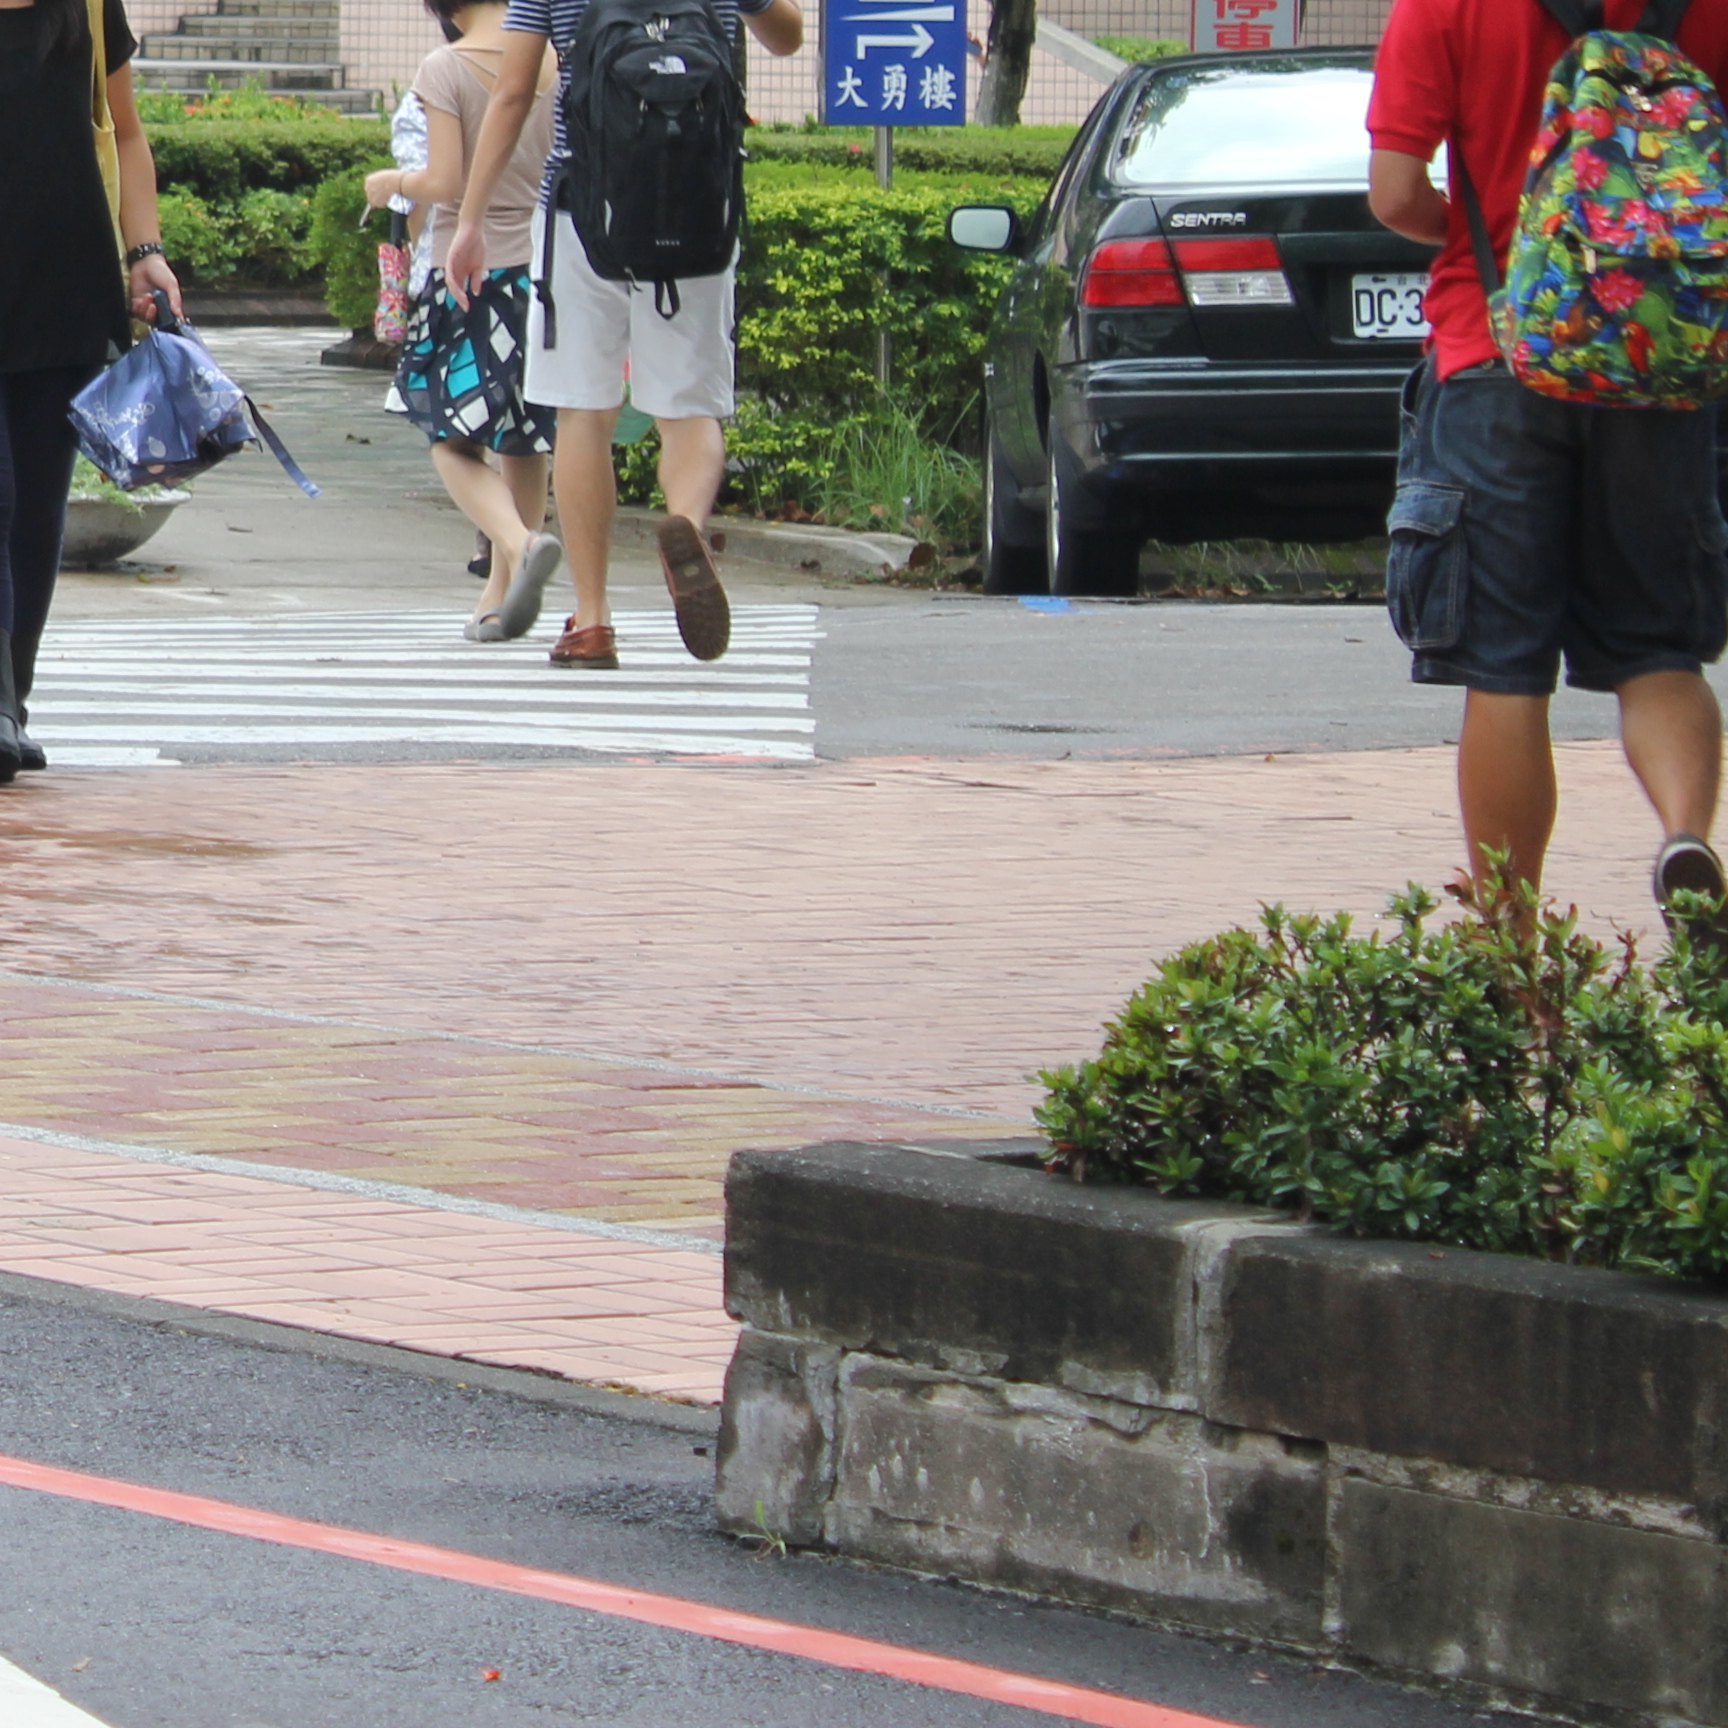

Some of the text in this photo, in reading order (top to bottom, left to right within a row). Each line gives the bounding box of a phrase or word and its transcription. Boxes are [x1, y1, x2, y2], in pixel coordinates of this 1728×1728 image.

[835, 64, 957, 112] 大勇樓
[1170, 212, 1247, 229] SENTRA
